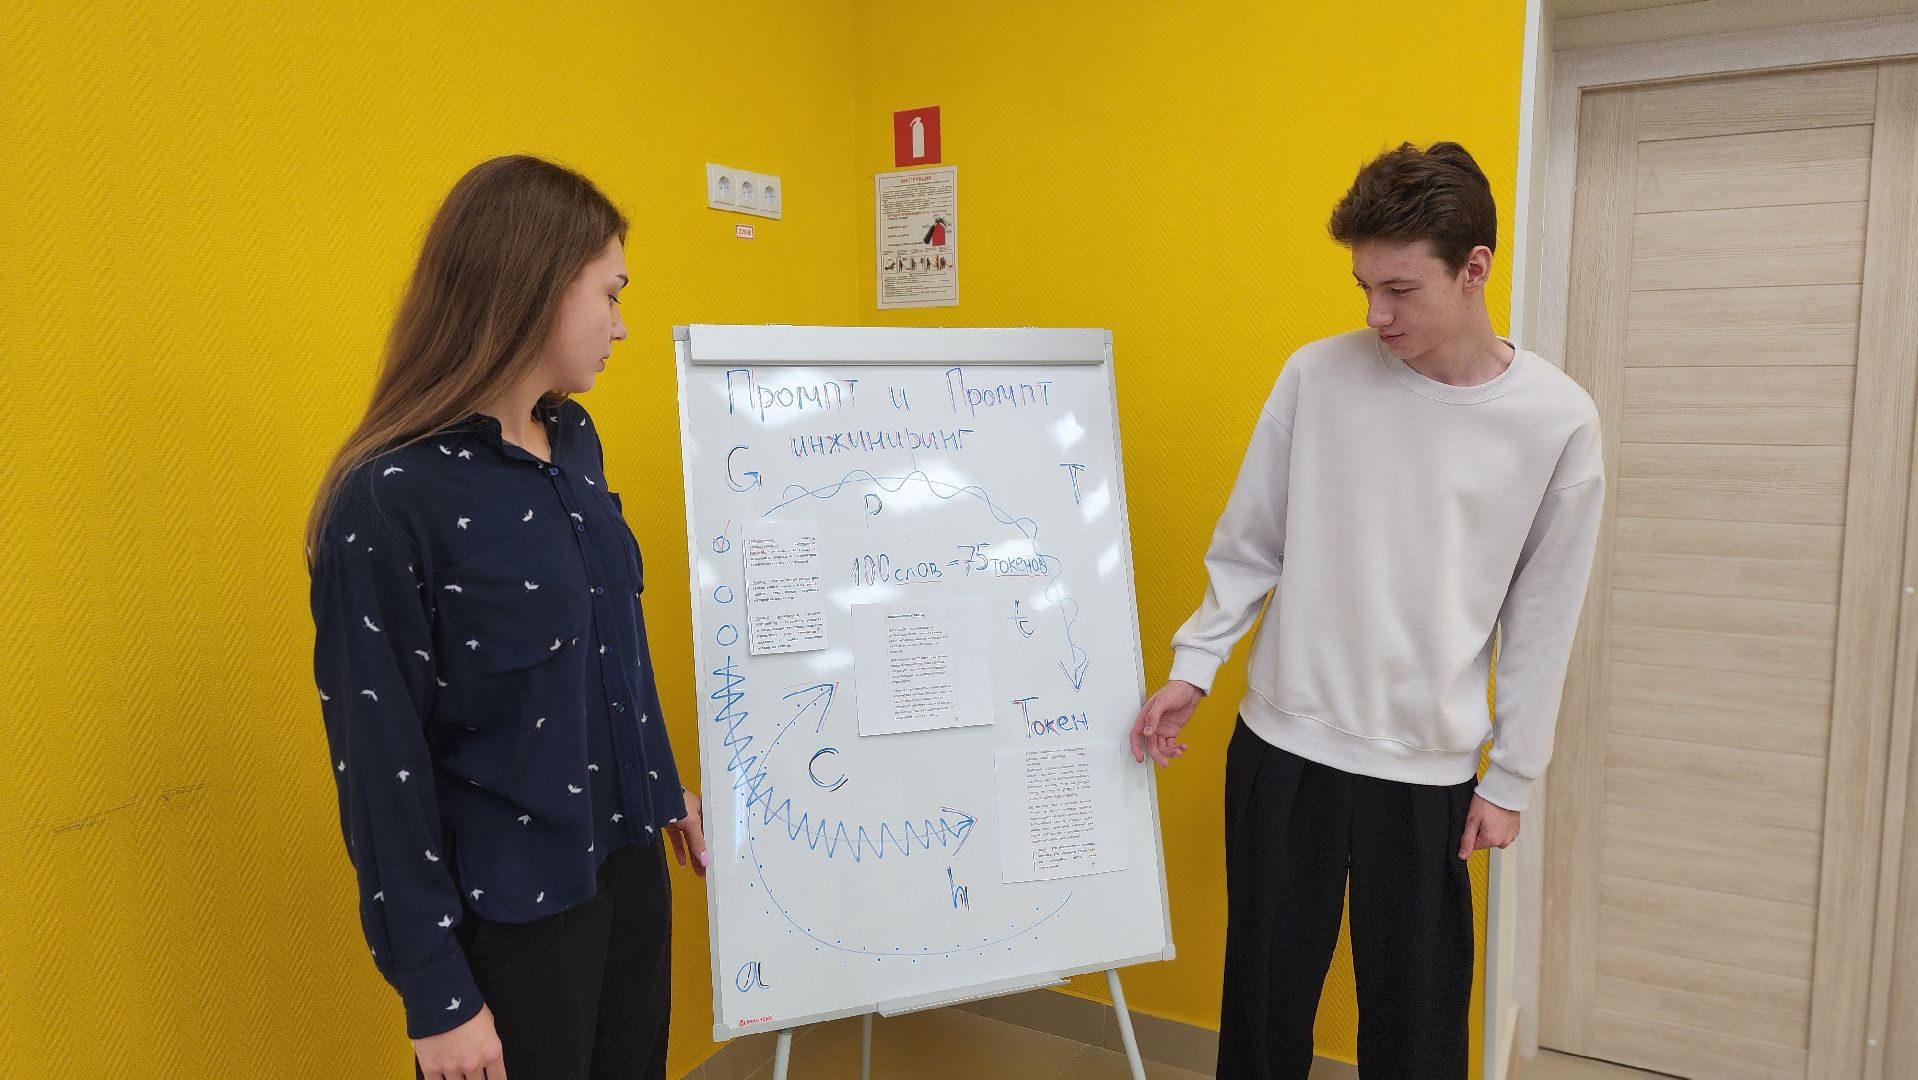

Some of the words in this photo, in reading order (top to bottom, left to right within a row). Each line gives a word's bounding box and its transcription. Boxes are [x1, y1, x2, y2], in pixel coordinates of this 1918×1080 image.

[727, 369, 859, 422] Промпт
[945, 367, 1053, 418] Промпт
[789, 428, 975, 471] инжиниринг
[851, 553, 890, 587] 100
[894, 562, 943, 582] слов
[1010, 697, 1089, 739] Токен
